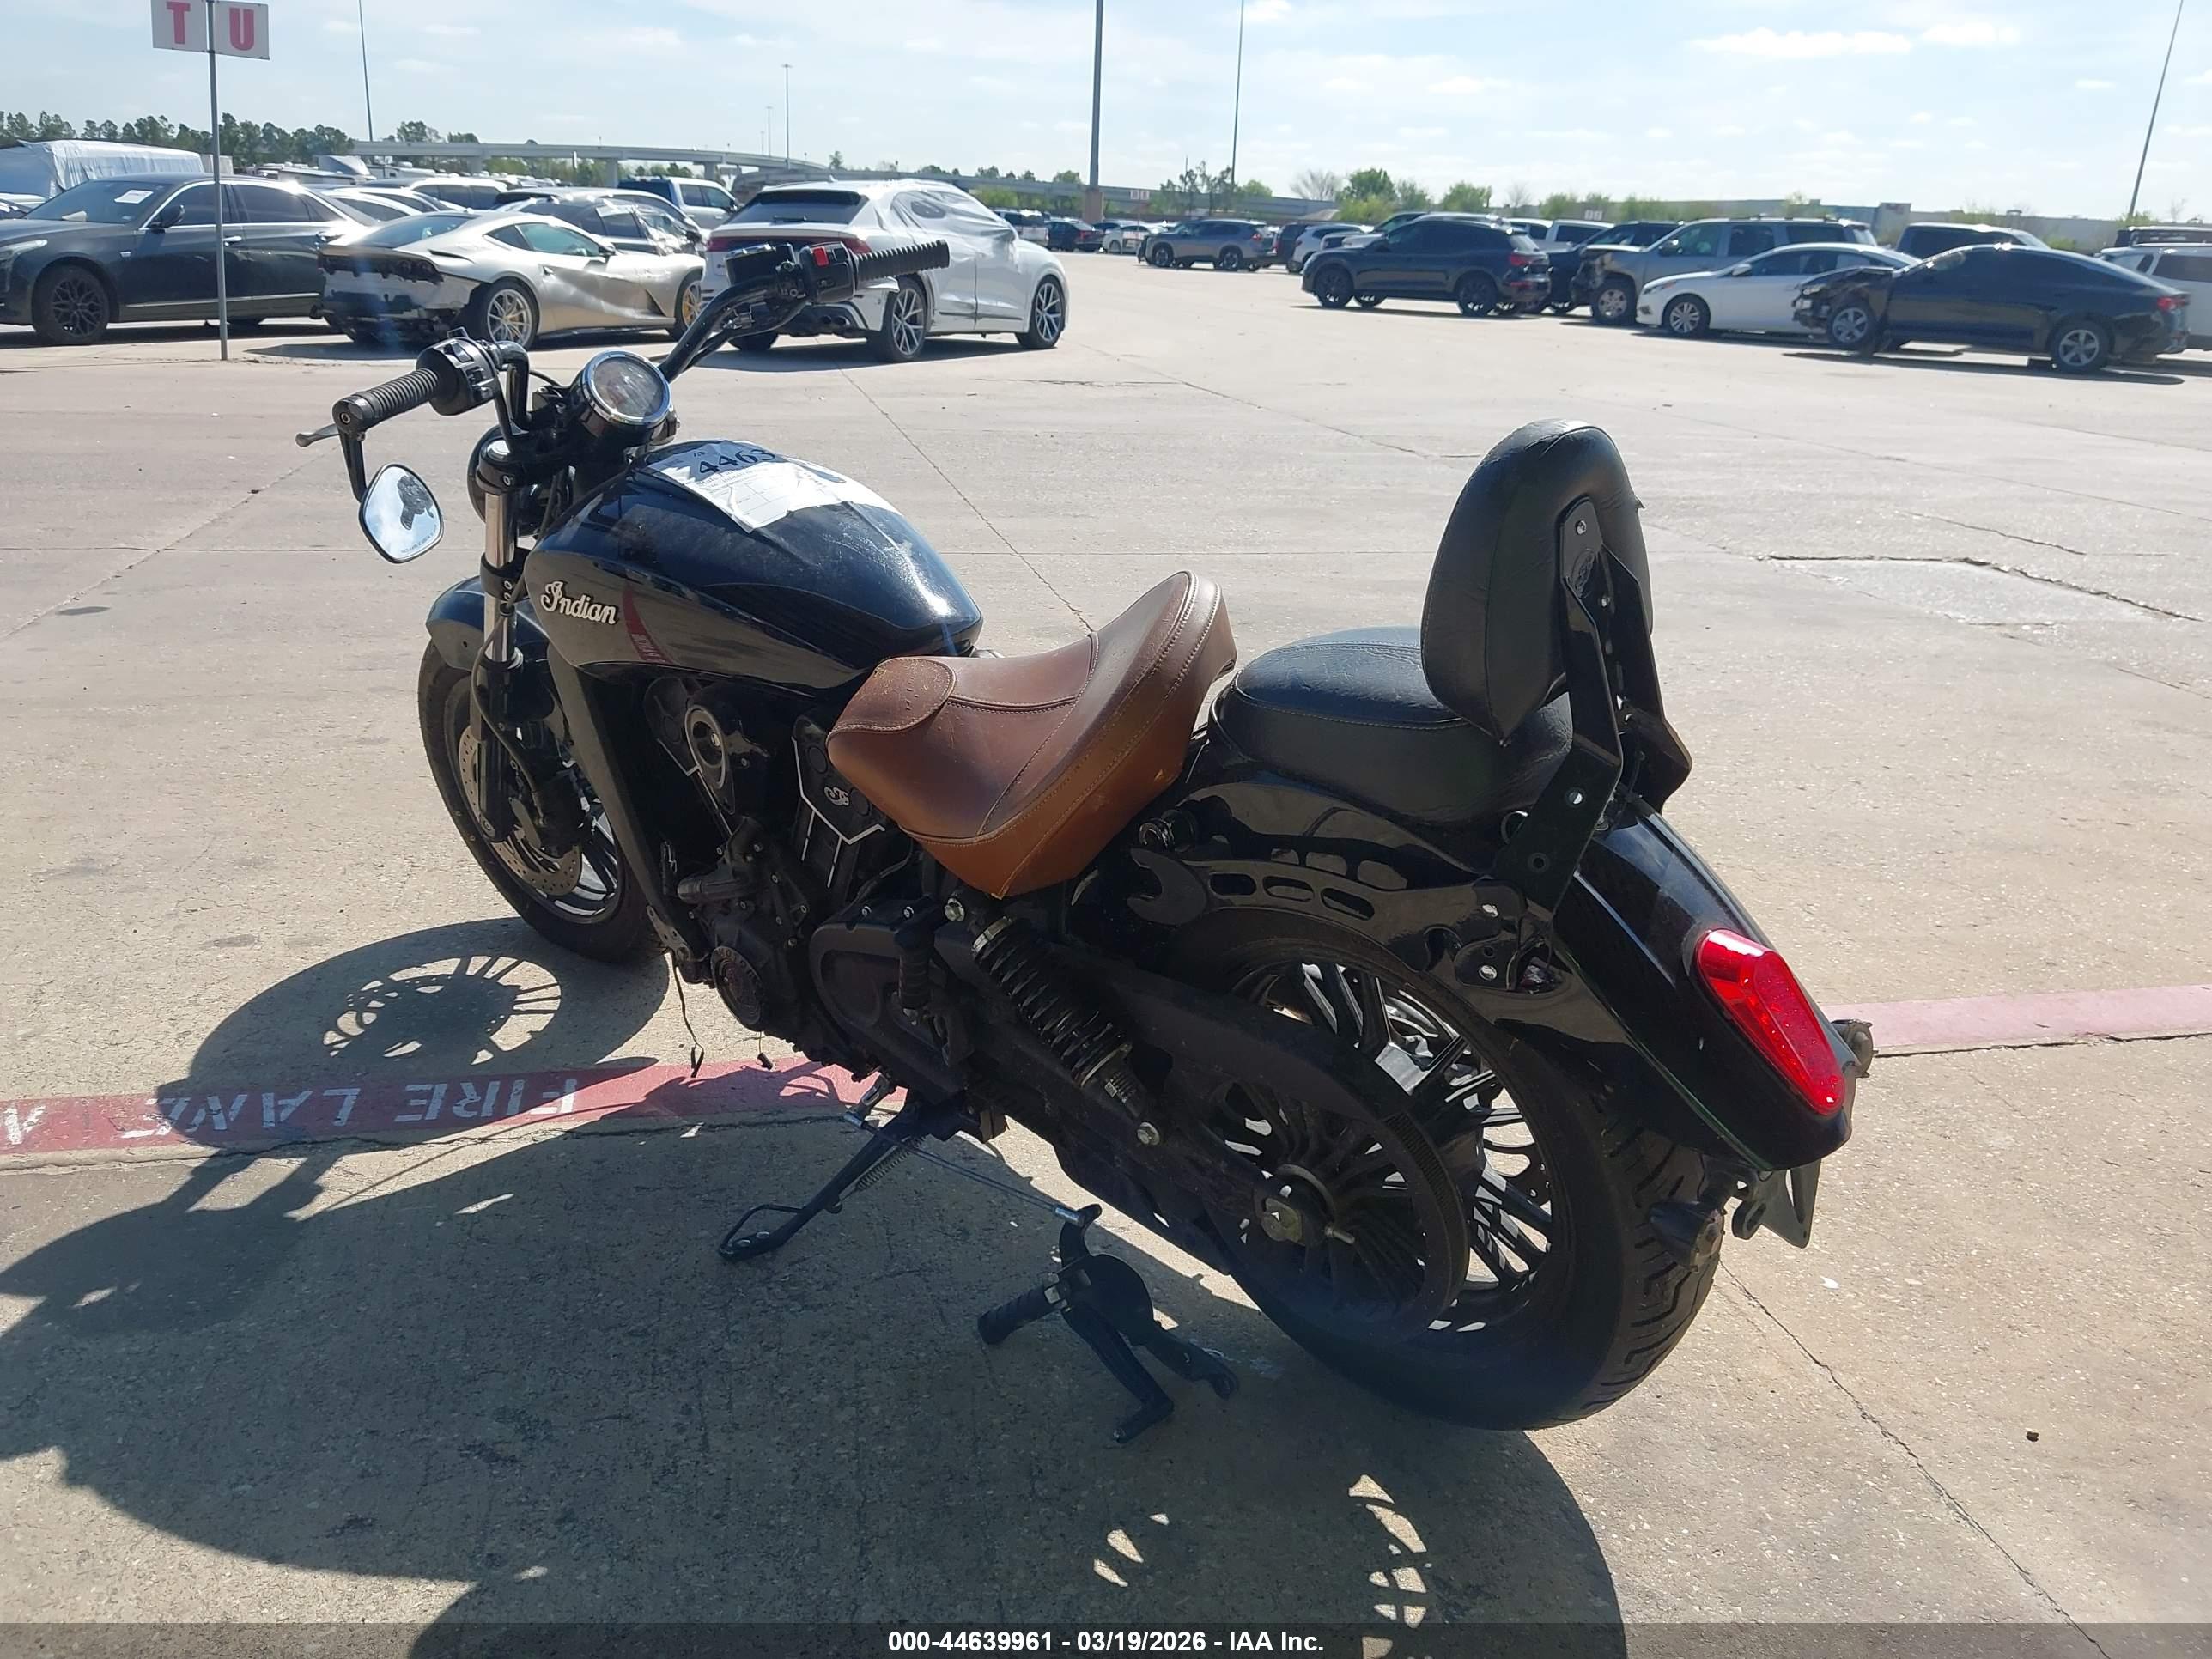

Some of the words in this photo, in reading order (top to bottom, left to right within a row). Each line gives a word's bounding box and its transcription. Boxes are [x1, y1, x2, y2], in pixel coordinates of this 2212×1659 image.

[167, 1, 191, 44] T
[229, 7, 255, 51] U
[540, 580, 617, 624] Indian
[120, 1088, 361, 1139] LANE
[394, 1079, 577, 1122] FIRE
